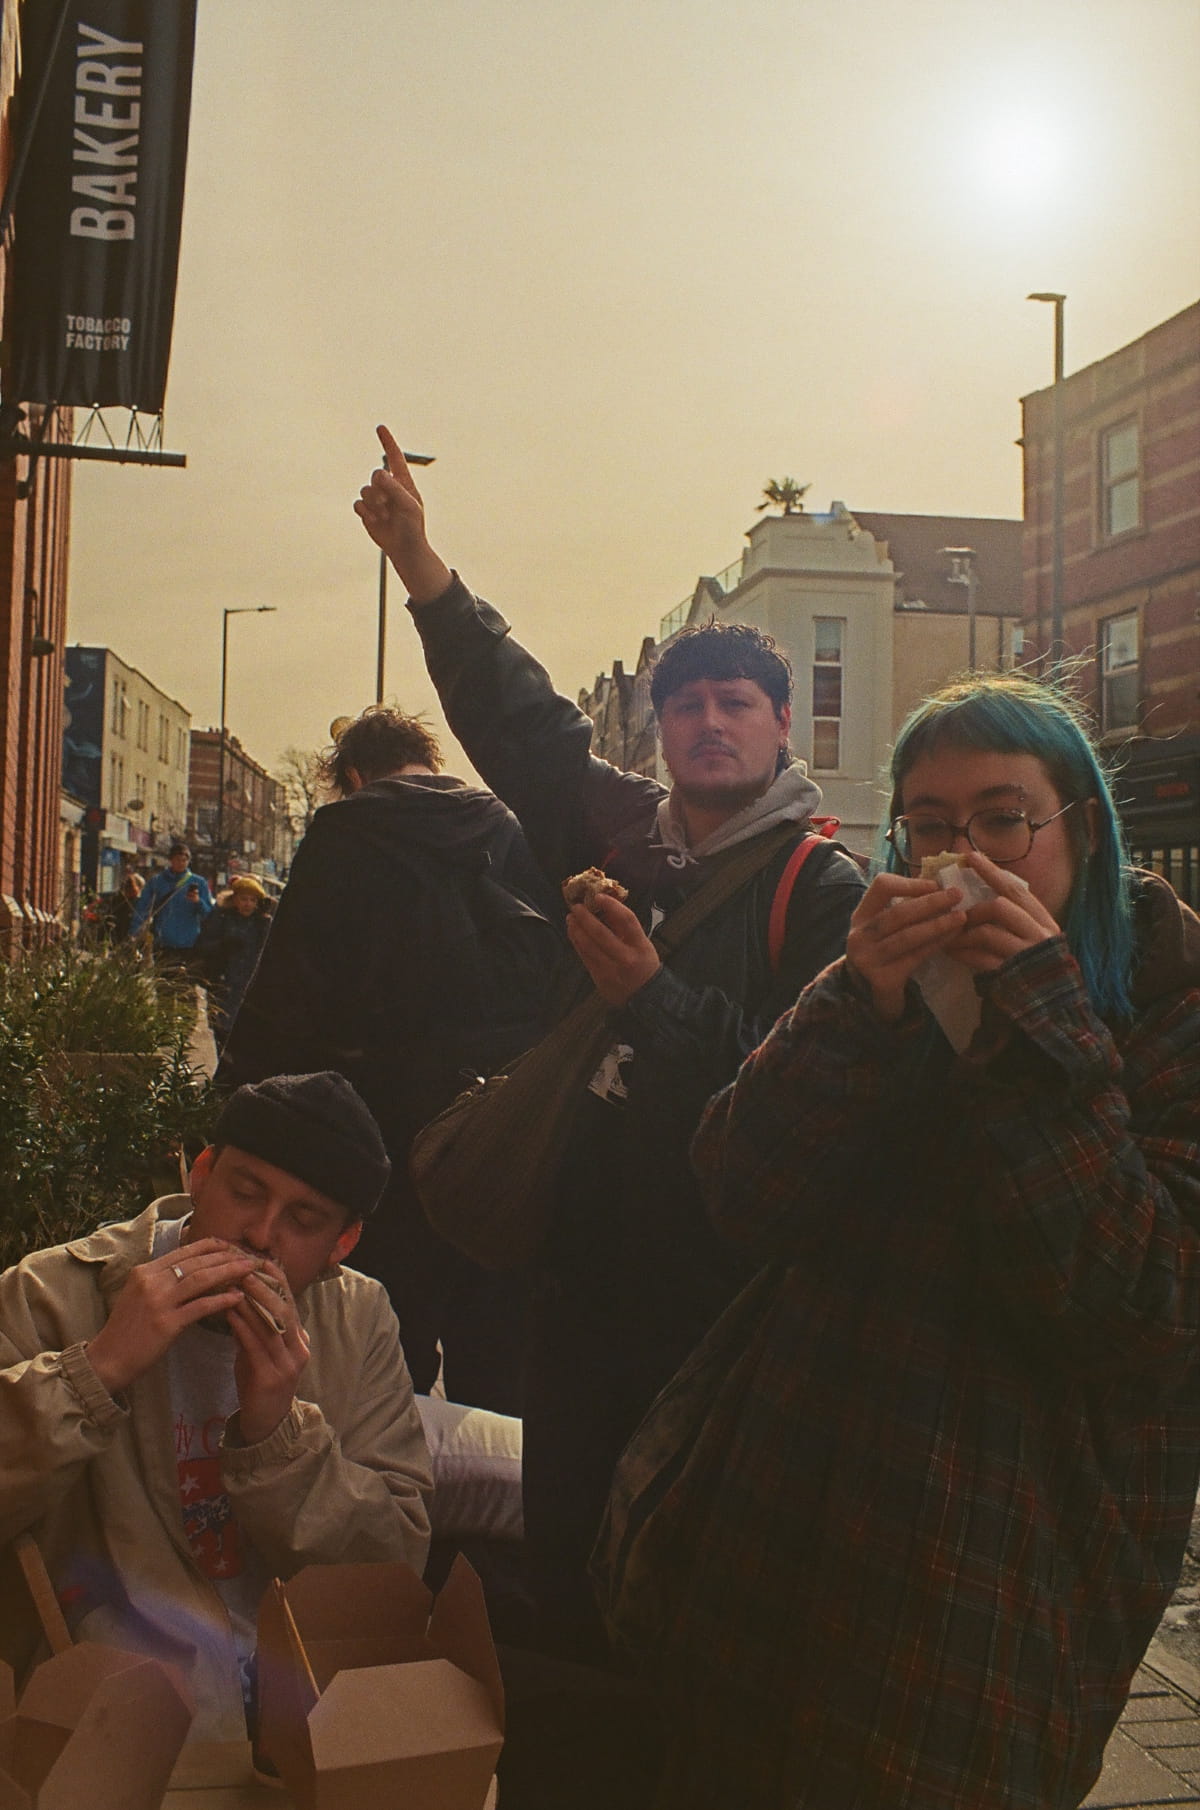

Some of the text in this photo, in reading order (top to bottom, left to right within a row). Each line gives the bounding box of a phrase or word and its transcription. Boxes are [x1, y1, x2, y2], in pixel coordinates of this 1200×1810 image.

[70, 23, 144, 241] BAKERY
[66, 314, 131, 334] TOBACCO
[65, 332, 130, 352] FACTORY
